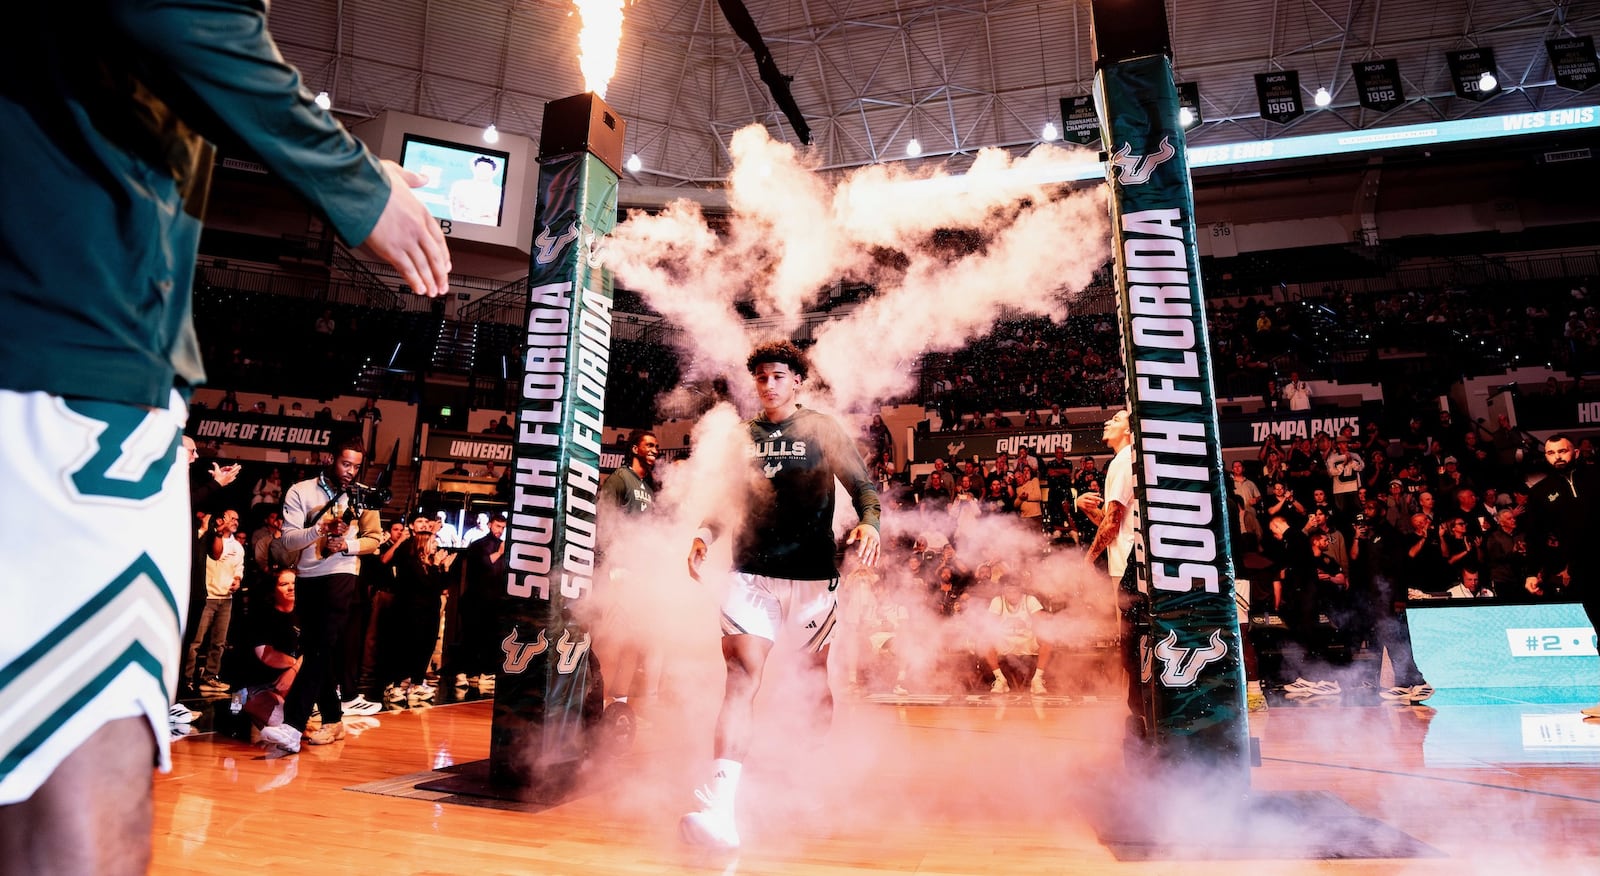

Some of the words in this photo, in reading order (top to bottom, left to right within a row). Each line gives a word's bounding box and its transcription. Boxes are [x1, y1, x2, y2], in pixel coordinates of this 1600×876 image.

[1364, 64, 1386, 72] NCAA
[1458, 53, 1481, 61] NCAA
[1266, 75, 1287, 83] NCAA
[1558, 66, 1597, 76] CHAMPIONS
[1267, 102, 1296, 114] 1990
[1367, 90, 1397, 103] 1992
[1503, 112, 1546, 131] WES
[1549, 107, 1594, 126] ENIS
[1190, 146, 1230, 164] WES
[1232, 141, 1274, 159] ENIS
[1213, 227, 1231, 237] 319
[1121, 208, 1203, 406] FLORIDA
[518, 281, 573, 446] FLORIDA
[572, 286, 614, 457] FLORIDA
[197, 420, 240, 439] HOME
[240, 424, 258, 440] OF
[260, 425, 287, 442] THE
[287, 428, 331, 446] BULLS
[1250, 419, 1308, 442] TAMPA
[1311, 416, 1360, 439] BAY'S
[996, 433, 1072, 455] @USFMBB
[1140, 418, 1220, 594] SOUTH
[507, 457, 560, 601] SOUTH
[560, 456, 601, 599] SOUTH
[1525, 635, 1562, 651] #2
